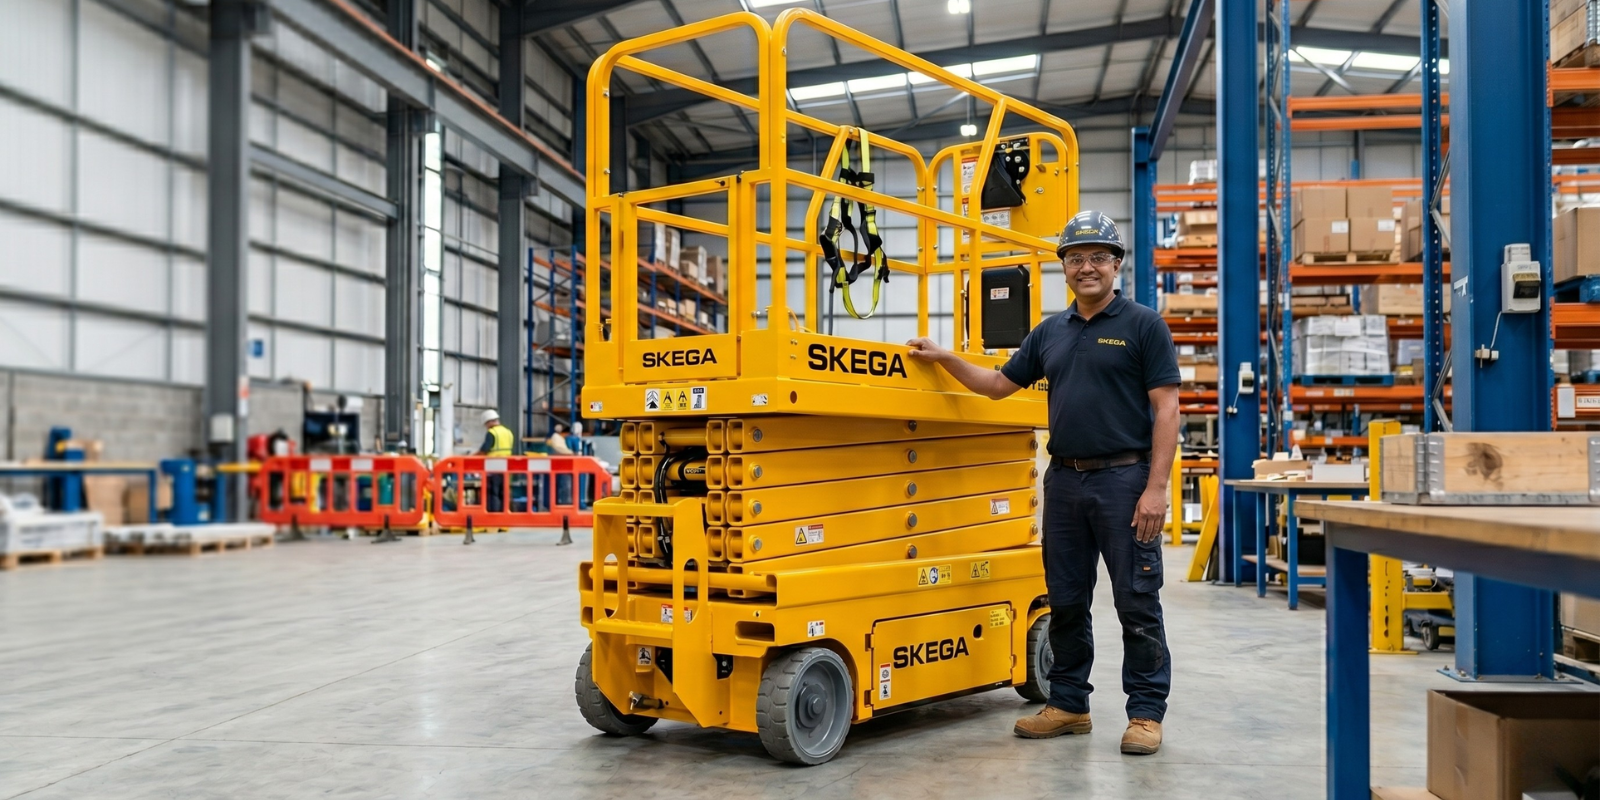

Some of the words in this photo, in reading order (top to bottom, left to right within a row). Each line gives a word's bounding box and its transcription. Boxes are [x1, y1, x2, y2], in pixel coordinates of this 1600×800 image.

[1097, 337, 1126, 347] SKEGA
[642, 348, 717, 368] SKEGA
[808, 343, 908, 379] SKEGA
[893, 636, 969, 669] SKEGA
